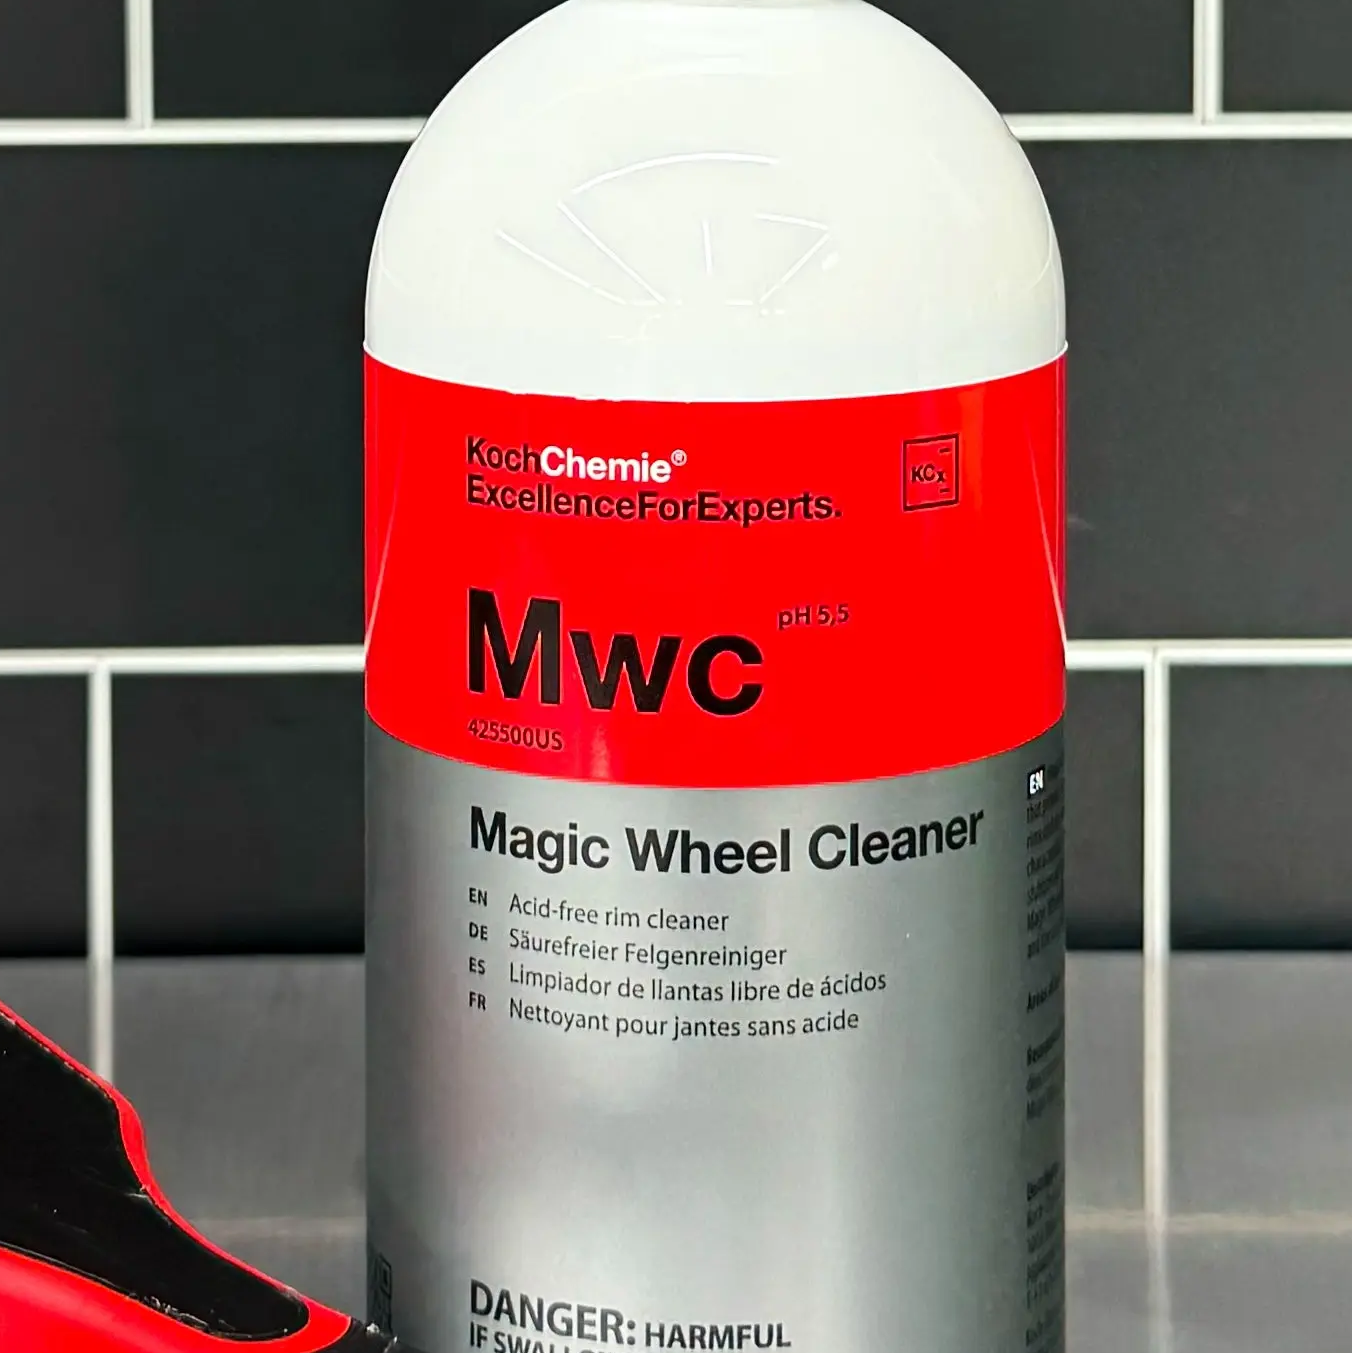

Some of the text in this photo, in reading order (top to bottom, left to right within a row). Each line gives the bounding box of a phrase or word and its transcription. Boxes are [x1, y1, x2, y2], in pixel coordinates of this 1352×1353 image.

[467, 474, 843, 528] ExcellenceForExperts.
[777, 603, 850, 631] pH 5,5
[468, 586, 765, 717] Mwc
[467, 718, 563, 751] 425500US
[470, 805, 985, 875] Magic Wheel Cleaner
[468, 886, 730, 933] EN Acid-free rim cleaner
[468, 921, 788, 972] DE Säurefreier Felgenreiniger
[468, 955, 887, 1003] ES Limpiador de llantas libre de ácidos
[468, 990, 859, 1041] FR Nettoyant pour jantes sans acide
[469, 1321, 488, 1349] IF
[470, 1278, 792, 1350] DANGER: HARMFUL
